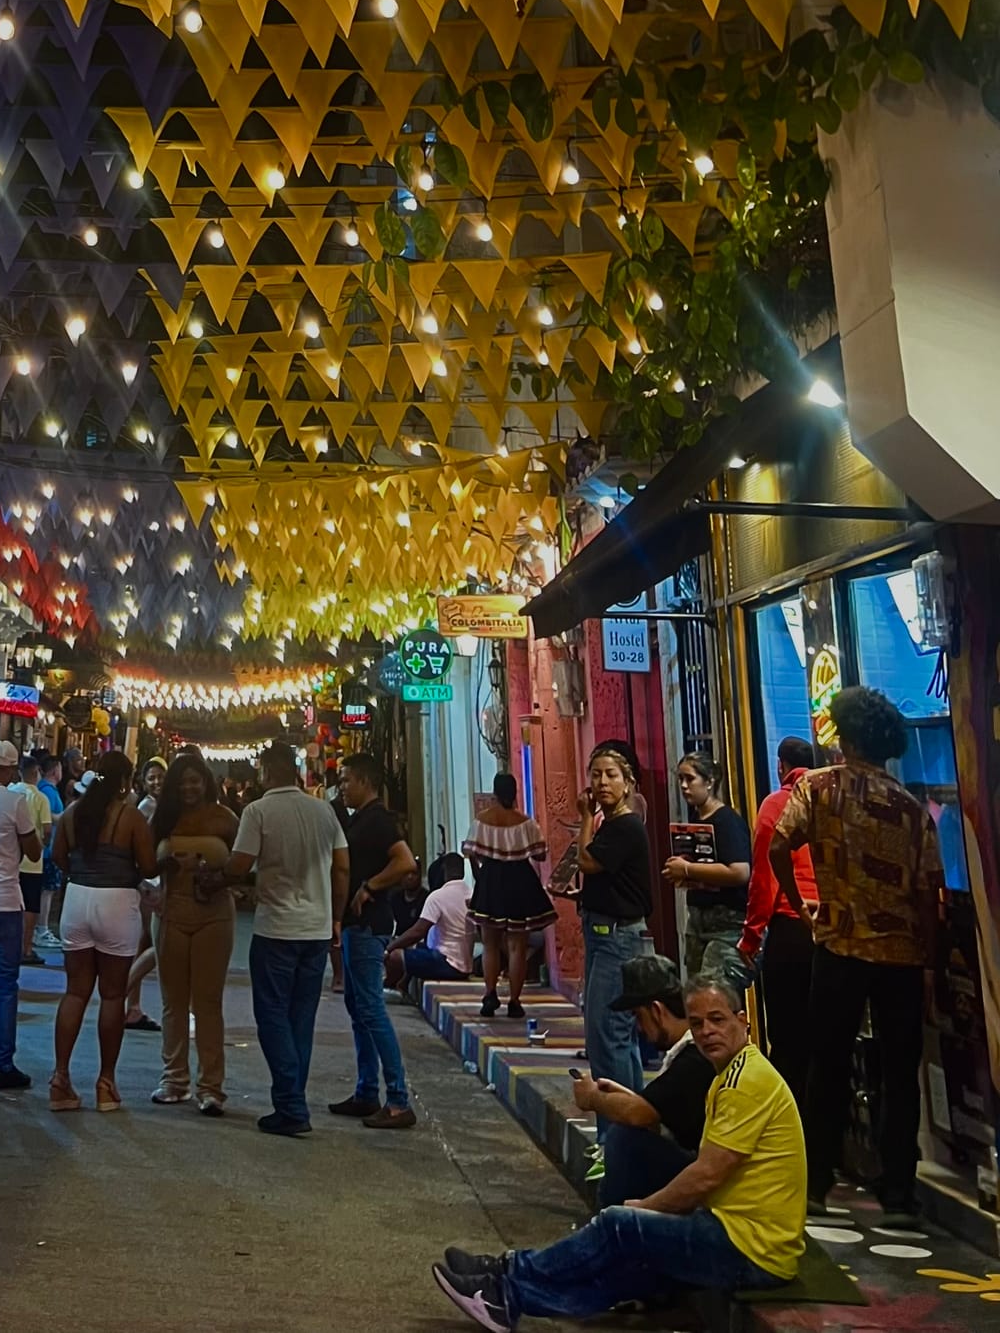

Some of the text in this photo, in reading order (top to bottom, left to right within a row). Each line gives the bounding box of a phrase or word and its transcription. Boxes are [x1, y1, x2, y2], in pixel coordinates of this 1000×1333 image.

[610, 630, 644, 648] Hostel
[405, 640, 450, 654] PURA
[611, 651, 645, 663] 30-28
[422, 688, 449, 698] ATM
